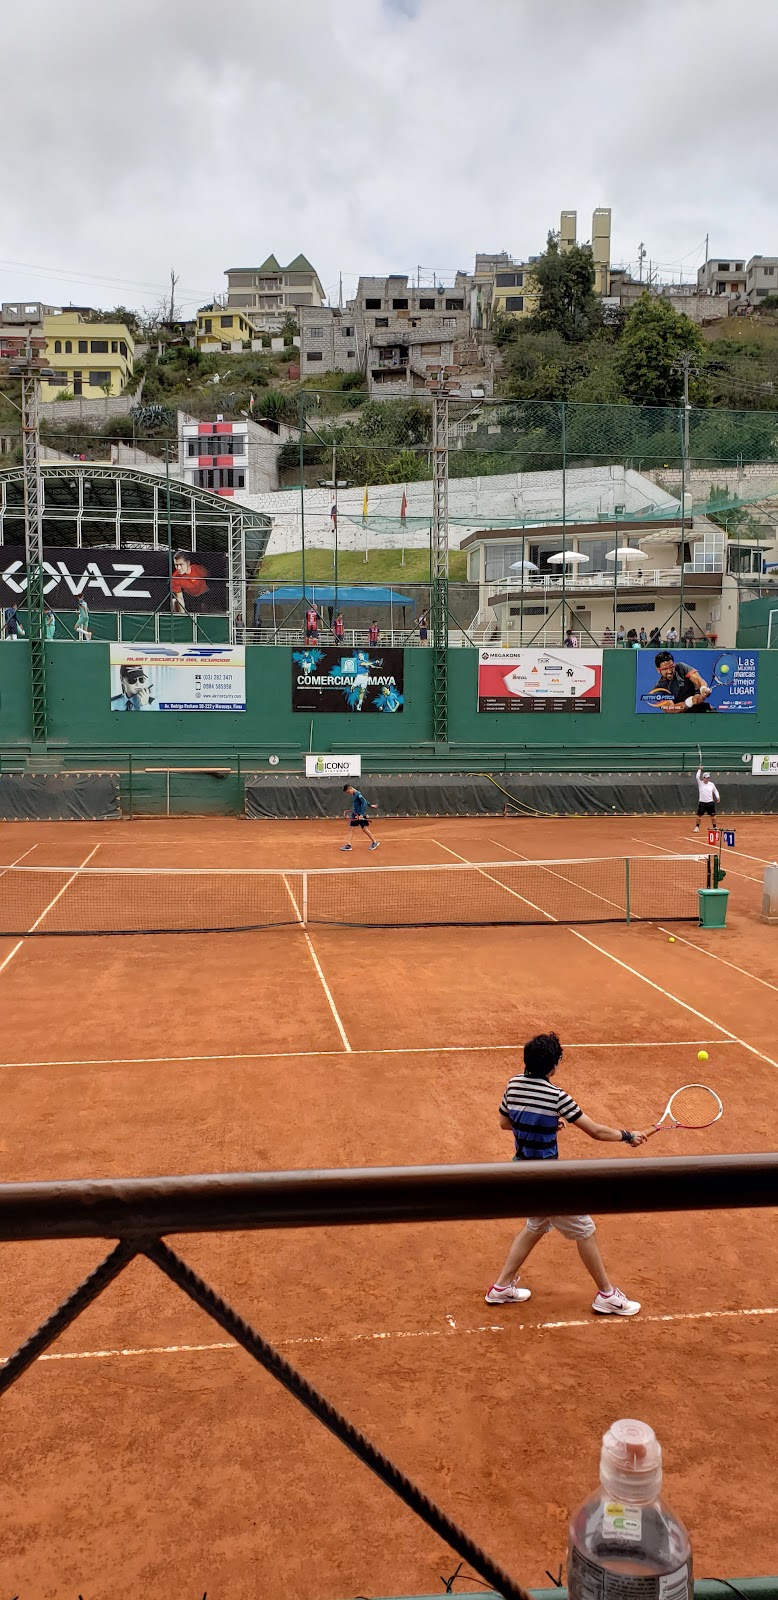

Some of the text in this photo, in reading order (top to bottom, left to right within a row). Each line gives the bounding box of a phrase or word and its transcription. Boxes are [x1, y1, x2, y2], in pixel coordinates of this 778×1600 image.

[738, 657, 755, 666] Las
[737, 678, 755, 686] mejor
[729, 686, 755, 695] LUGAR
[324, 762, 350, 770] ICONO
[710, 832, 714, 843] 0
[729, 833, 733, 845] 1
